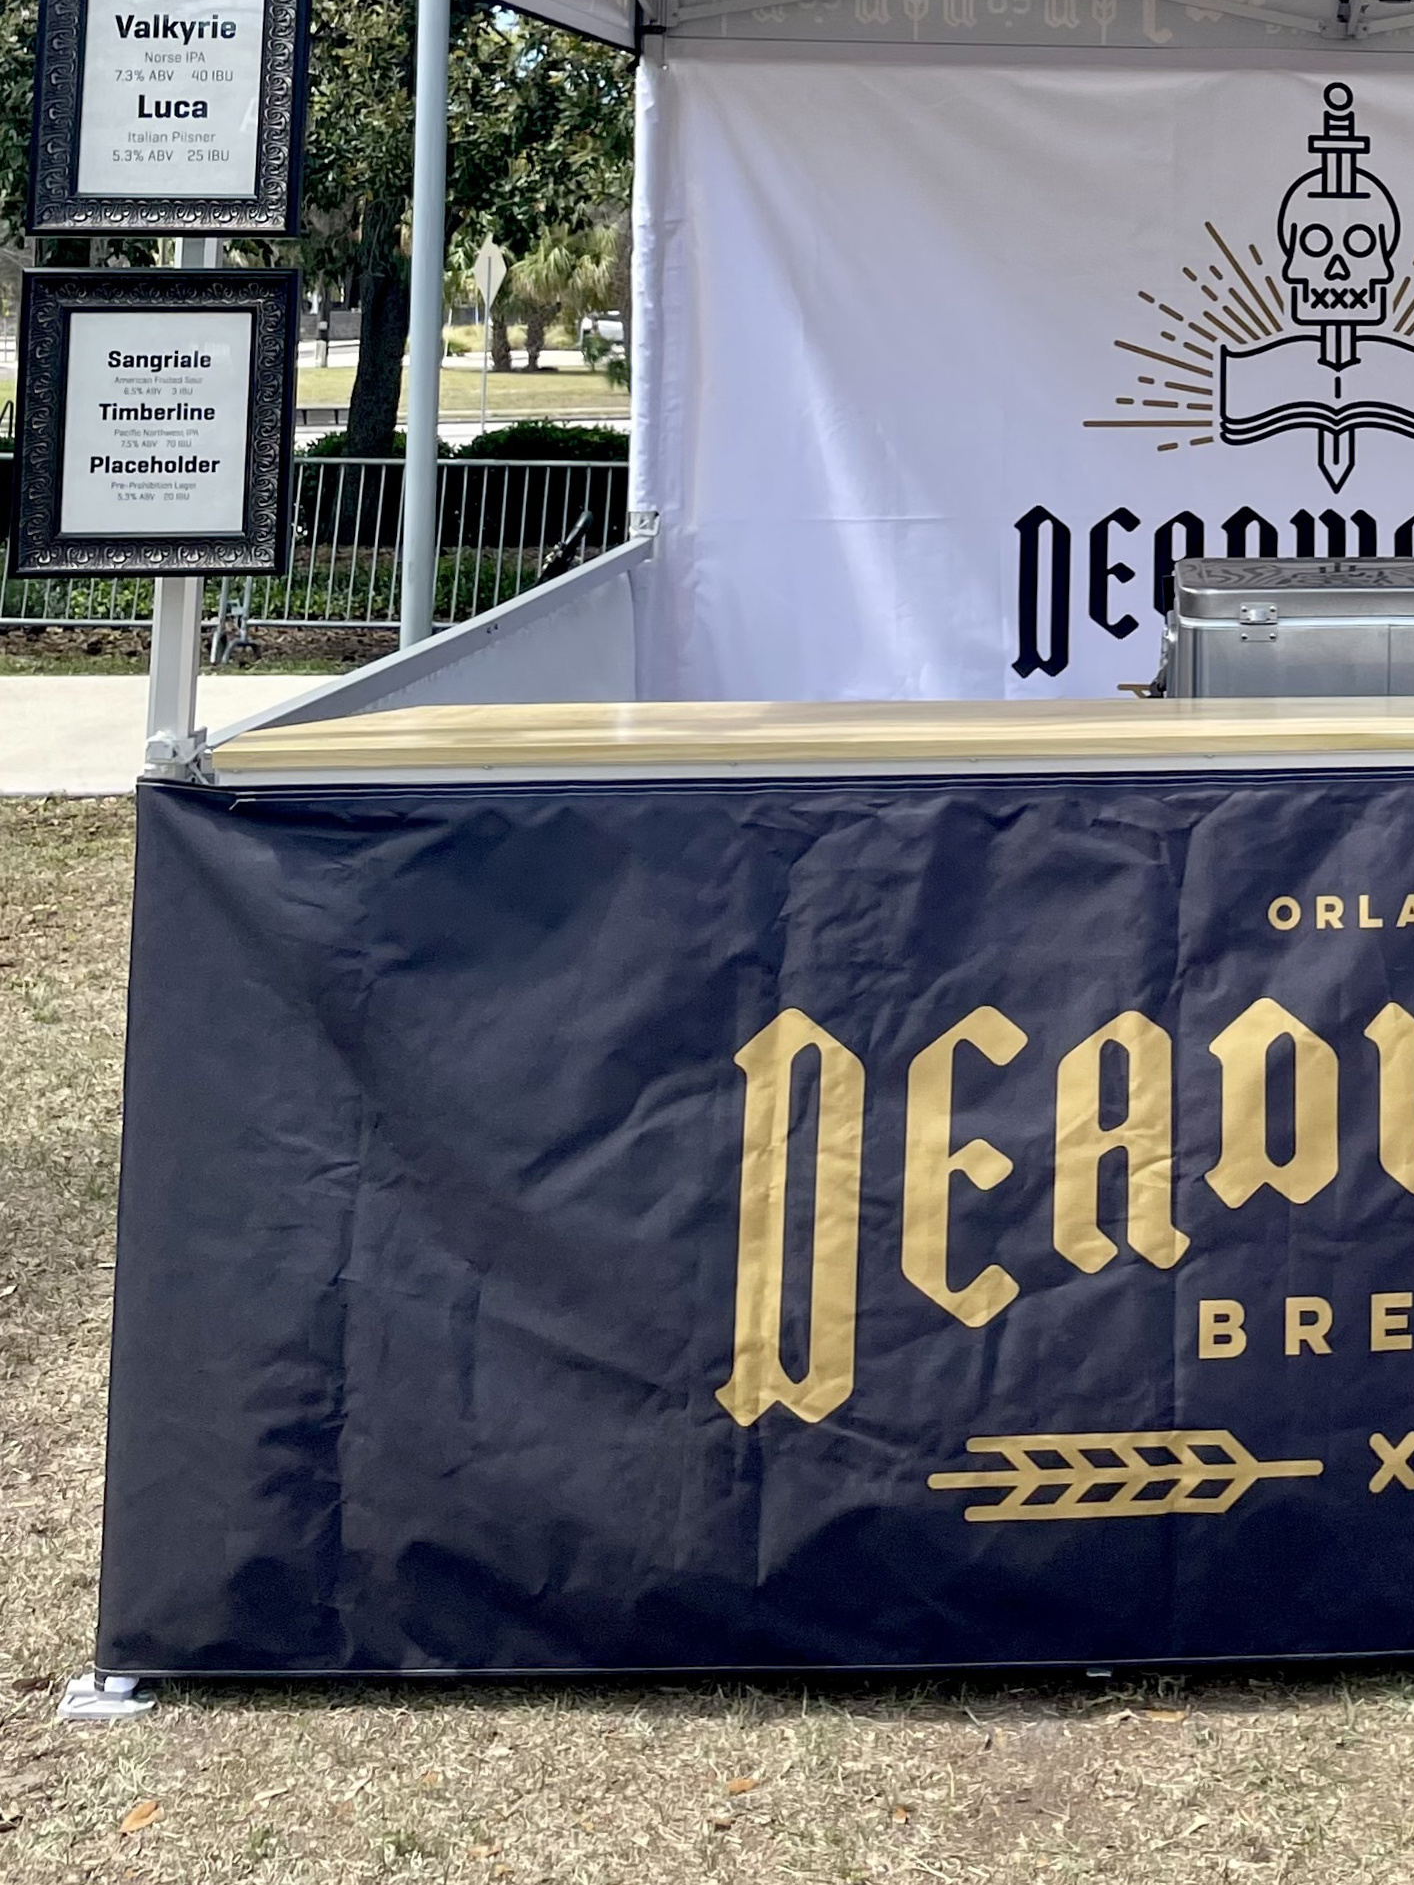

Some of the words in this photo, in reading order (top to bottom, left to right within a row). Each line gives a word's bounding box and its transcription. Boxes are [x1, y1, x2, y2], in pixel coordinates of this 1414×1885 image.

[115, 14, 237, 45] Valkyrie
[145, 52, 182, 63] Norse
[186, 52, 205, 63] IPA
[115, 70, 144, 82] 7.3%
[149, 70, 174, 82] ABV
[191, 70, 208, 82] 40
[212, 70, 233, 82] IBU
[138, 94, 208, 118] Luca
[128, 131, 167, 143] Italian
[172, 131, 216, 143] Pilsner
[112, 150, 144, 162] 5.3%
[148, 150, 174, 162] ABV
[187, 150, 204, 162] 25
[208, 150, 230, 162] IBU
[108, 350, 212, 372] Sangriale
[99, 403, 215, 421] Timberline
[90, 455, 220, 474] Placeholder
